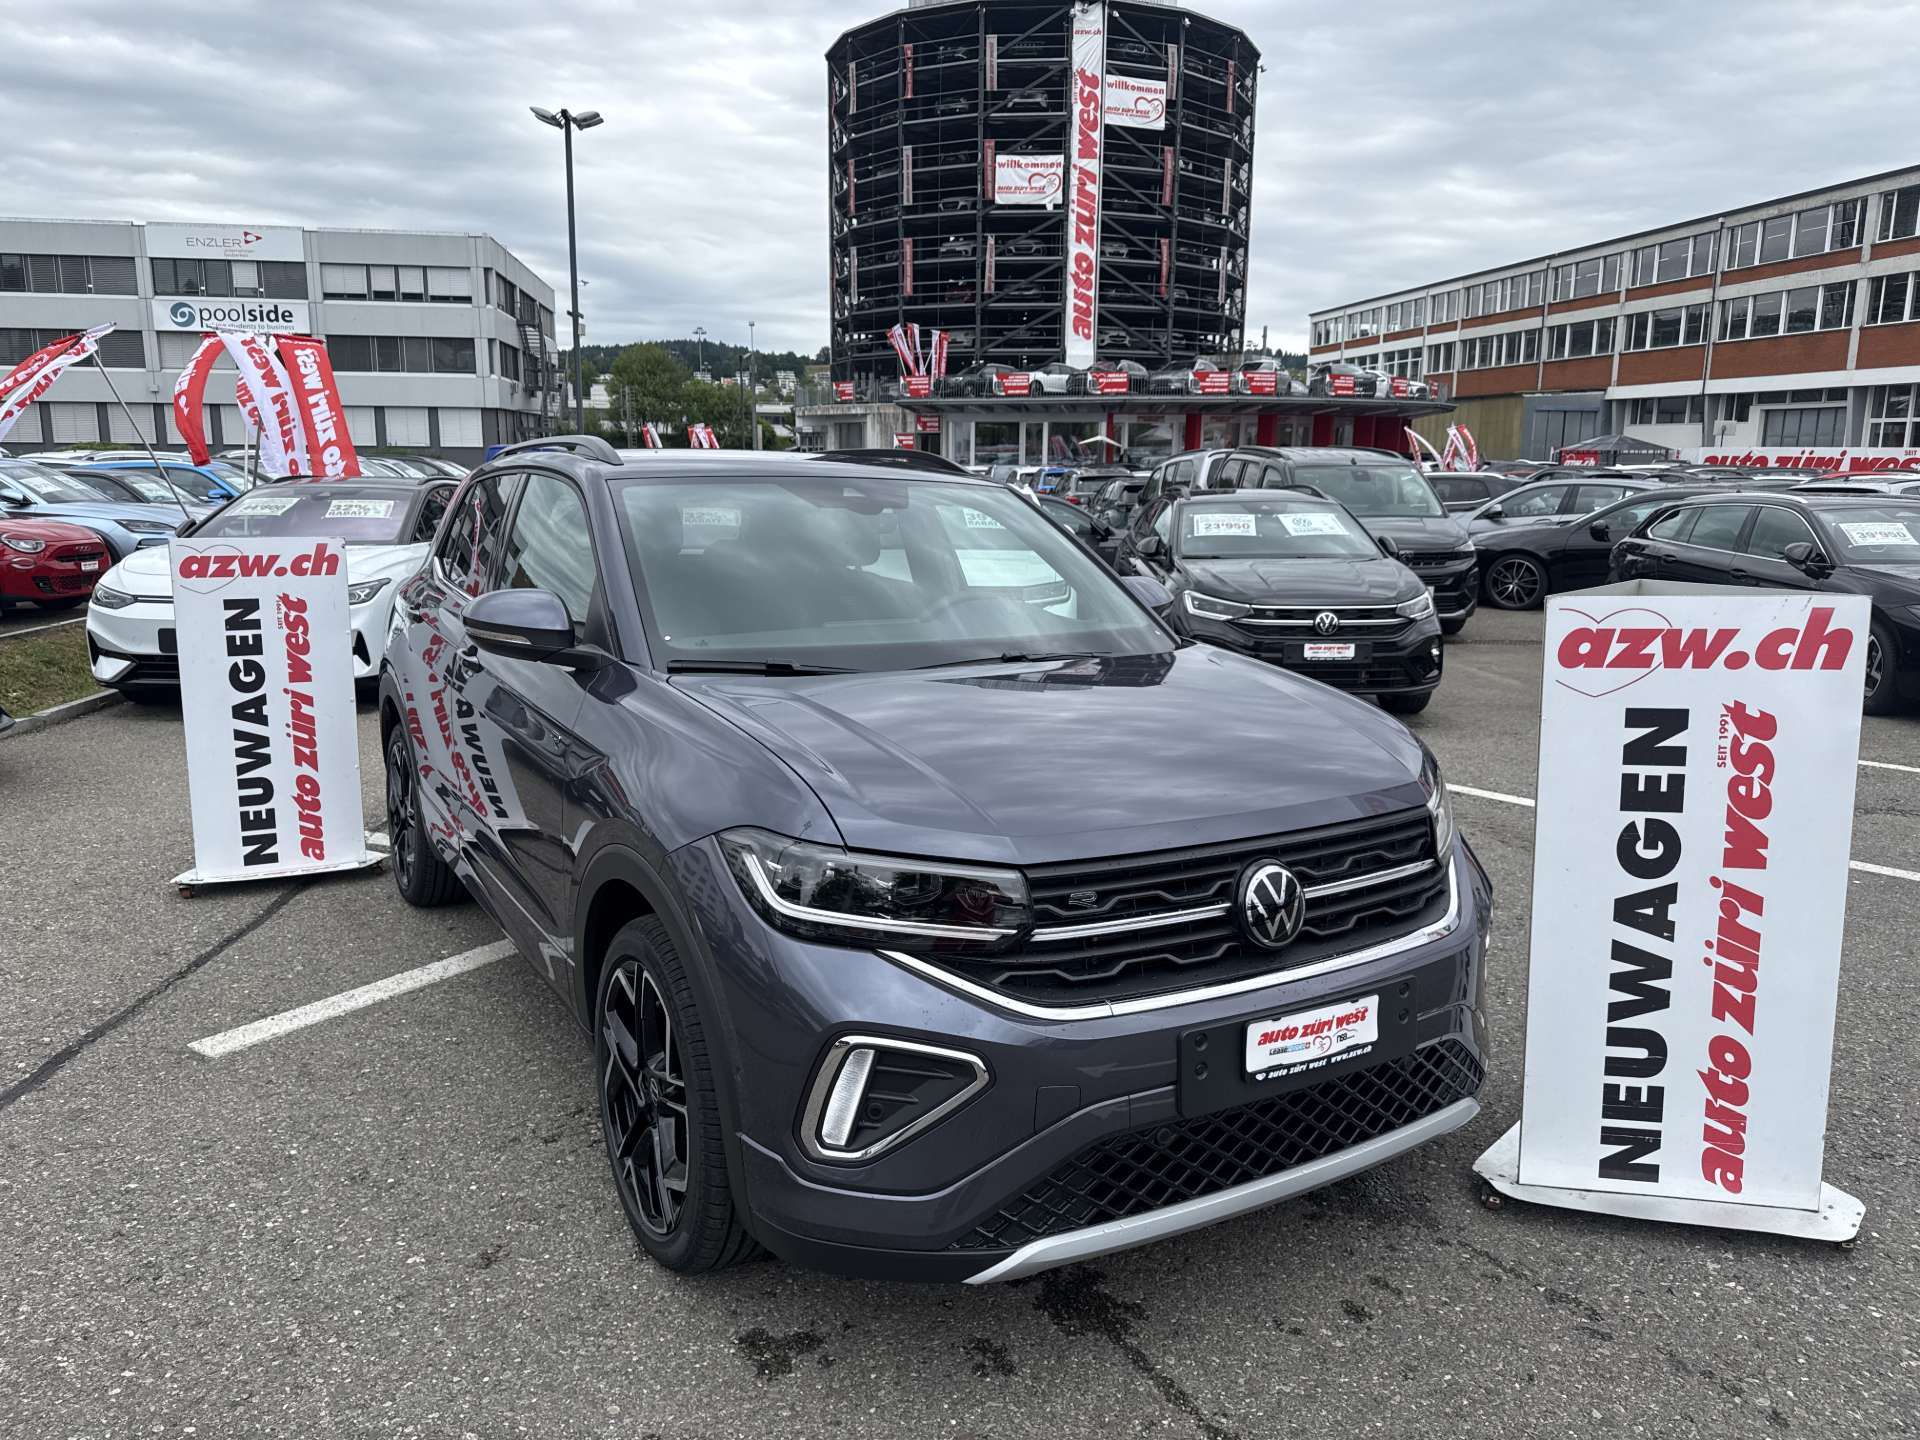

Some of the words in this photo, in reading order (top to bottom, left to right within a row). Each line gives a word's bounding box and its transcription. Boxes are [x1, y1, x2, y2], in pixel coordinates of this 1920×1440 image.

[1076, 67, 1100, 160] west
[1106, 80, 1165, 95] willkommen
[997, 159, 1062, 169] willkommen
[186, 236, 242, 247] ENZLER
[1072, 163, 1098, 251] züri
[199, 304, 294, 329] poolside
[1070, 251, 1094, 340] auto
[178, 543, 340, 579] azw.ch
[276, 592, 313, 684] west
[1556, 607, 1854, 672] azw.ch
[222, 598, 279, 867] NEUWAGEN
[283, 688, 319, 772] züri
[1716, 745, 1728, 768] SEIT
[1719, 714, 1729, 740] 1991
[290, 774, 326, 861] auto
[1722, 700, 1779, 870] west
[1598, 707, 1691, 1184] NEUWAGEN
[1703, 876, 1765, 1037] züri
[1257, 1026, 1298, 1046] auto
[1299, 1014, 1335, 1039] züri
[1336, 1007, 1369, 1029] west
[1268, 1068, 1288, 1079] auto
[1289, 1063, 1308, 1074] züri
[1309, 1058, 1328, 1069] west
[1330, 1045, 1373, 1064] www.azw.ch
[1696, 1034, 1754, 1195] auto
